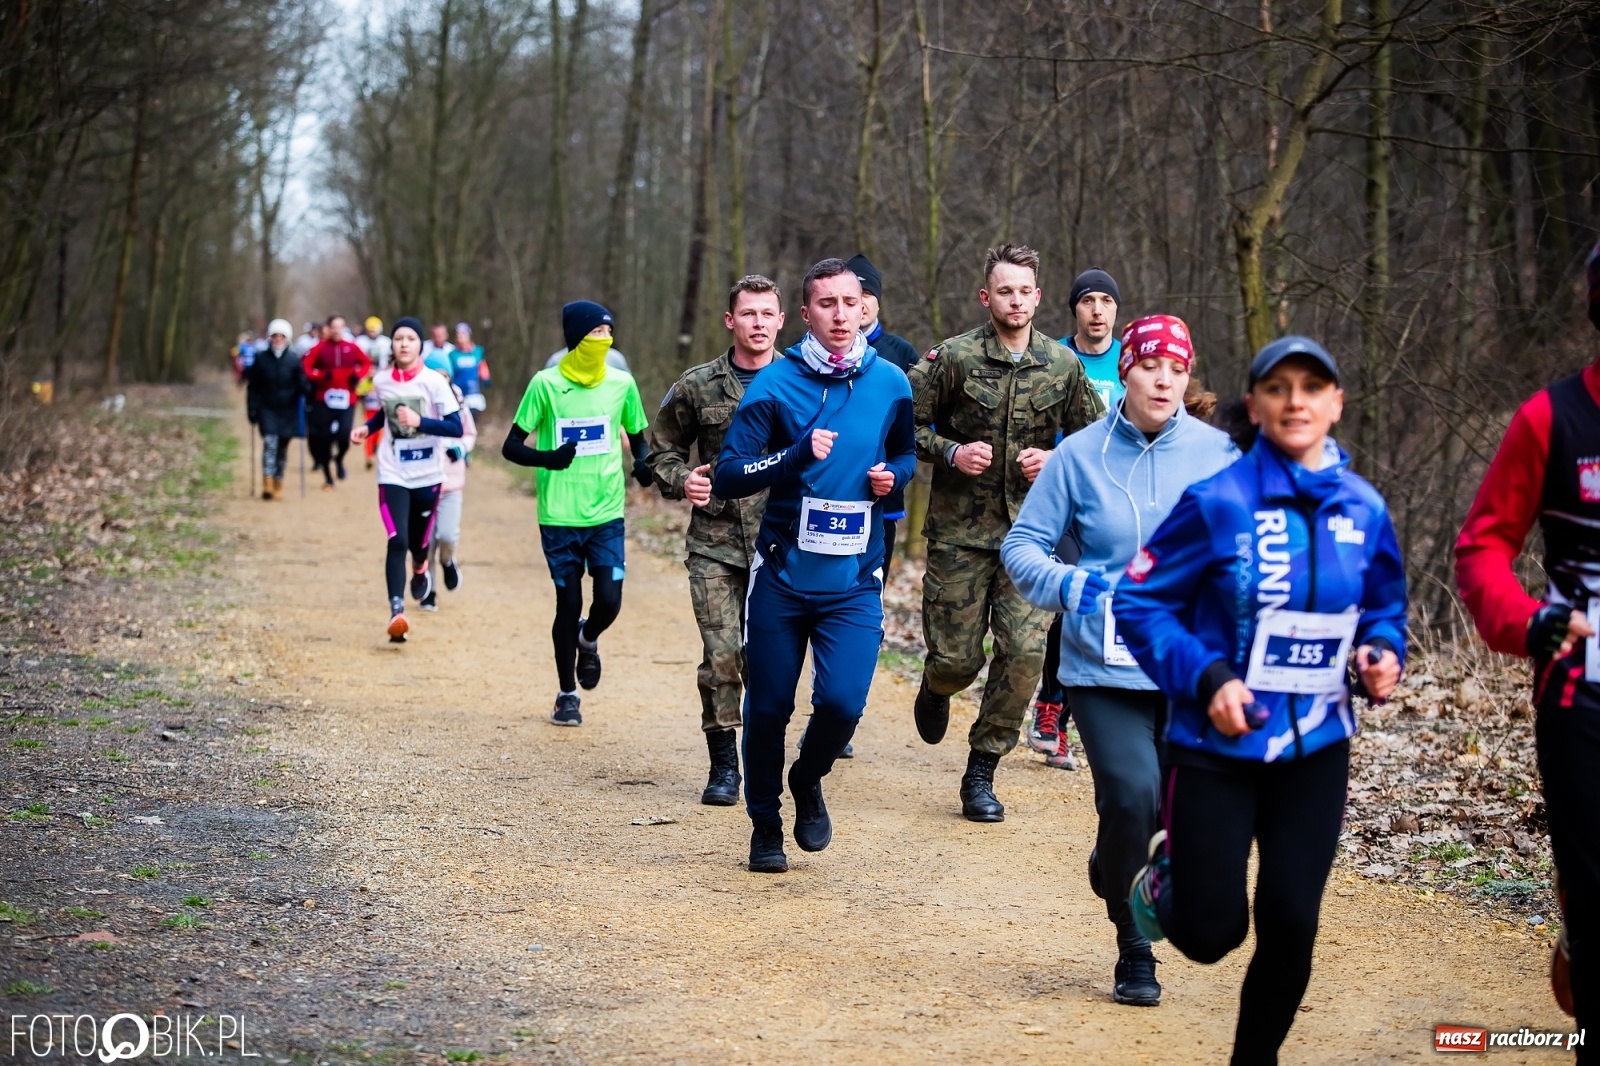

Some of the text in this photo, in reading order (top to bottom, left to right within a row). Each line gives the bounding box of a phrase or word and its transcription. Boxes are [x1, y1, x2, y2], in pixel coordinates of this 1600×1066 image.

[580, 429, 587, 439] 2
[411, 450, 423, 460] 79
[829, 517, 847, 530] 34
[1287, 643, 1324, 665] 155
